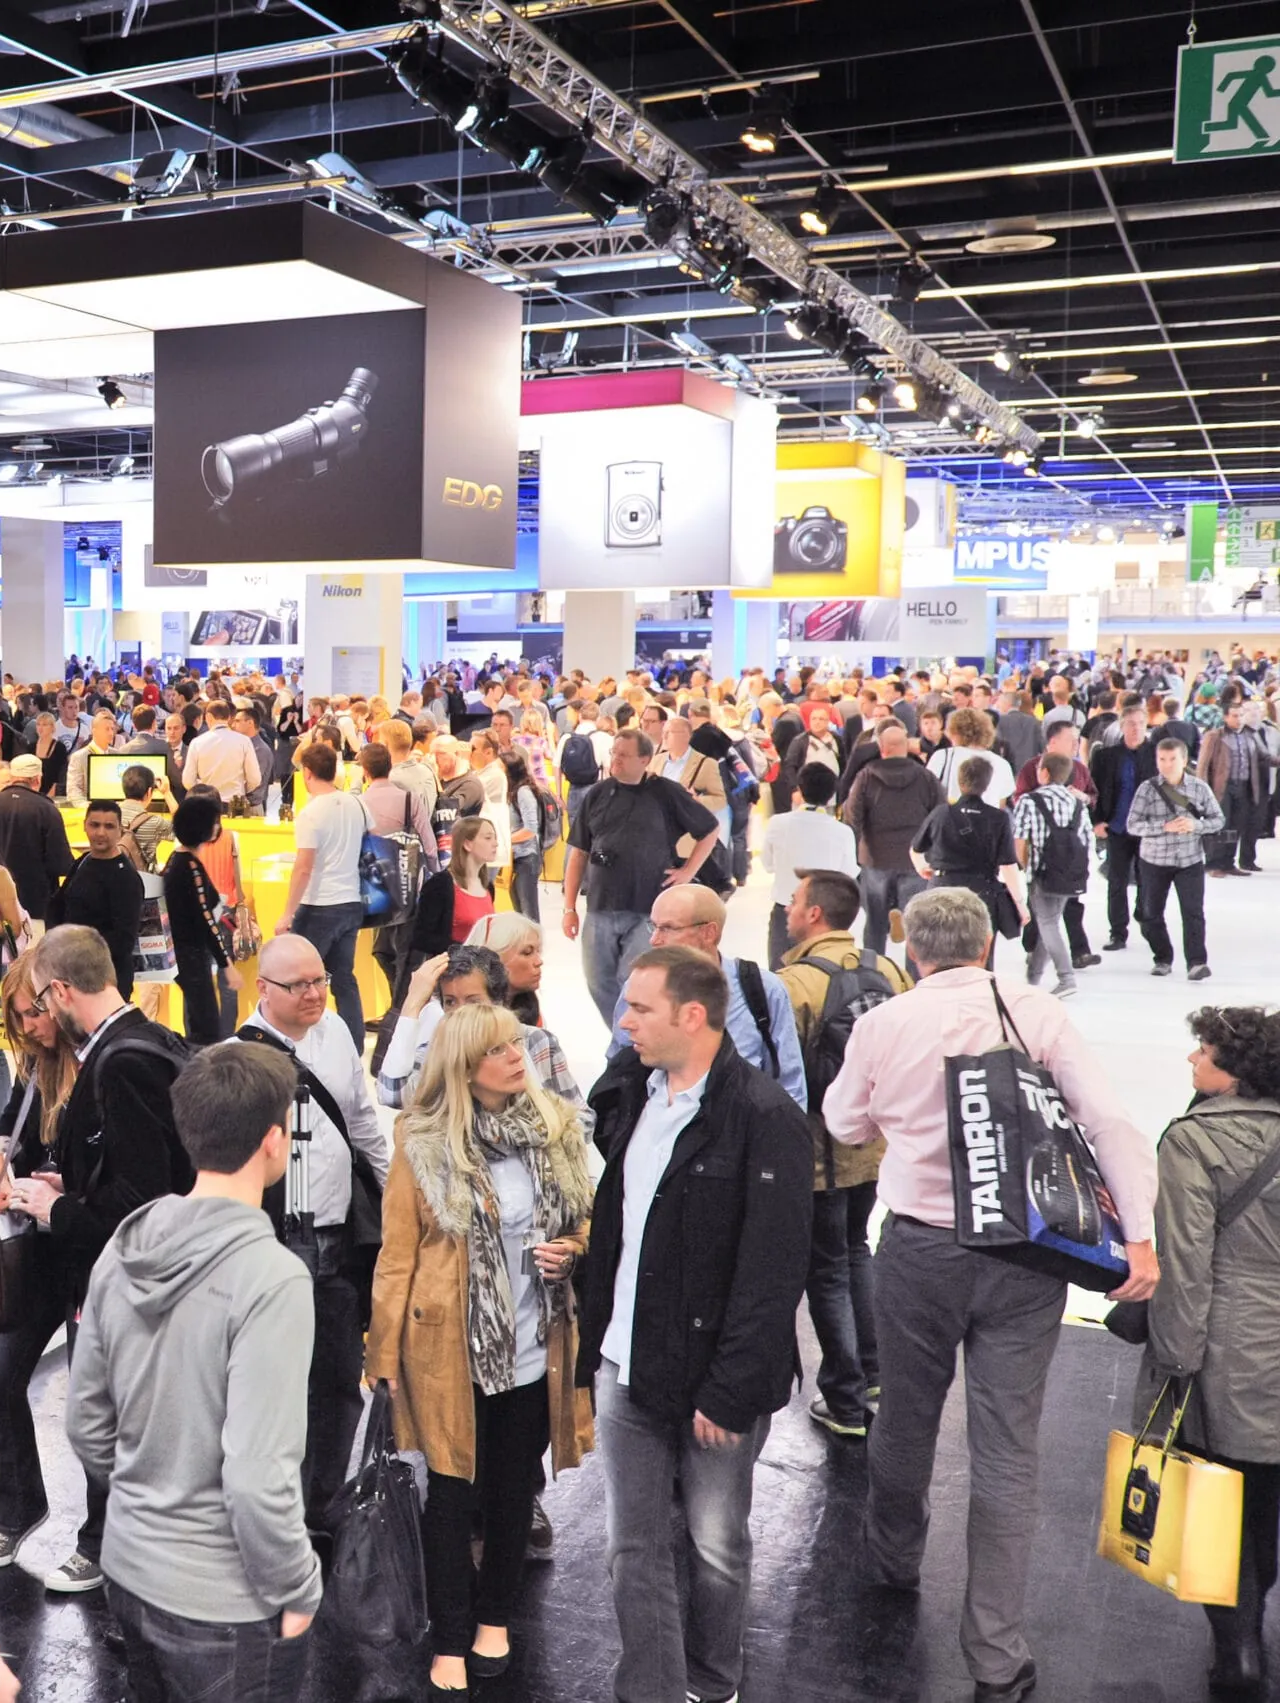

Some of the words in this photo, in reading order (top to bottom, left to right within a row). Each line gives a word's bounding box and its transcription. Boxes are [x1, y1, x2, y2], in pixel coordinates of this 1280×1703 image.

[441, 476, 504, 512] EDG
[956, 540, 1053, 571] MPUS
[322, 585, 362, 598] Nikon
[906, 601, 958, 617] HELLO
[140, 940, 165, 950] SIGMA
[959, 1069, 1004, 1233] TAMRON
